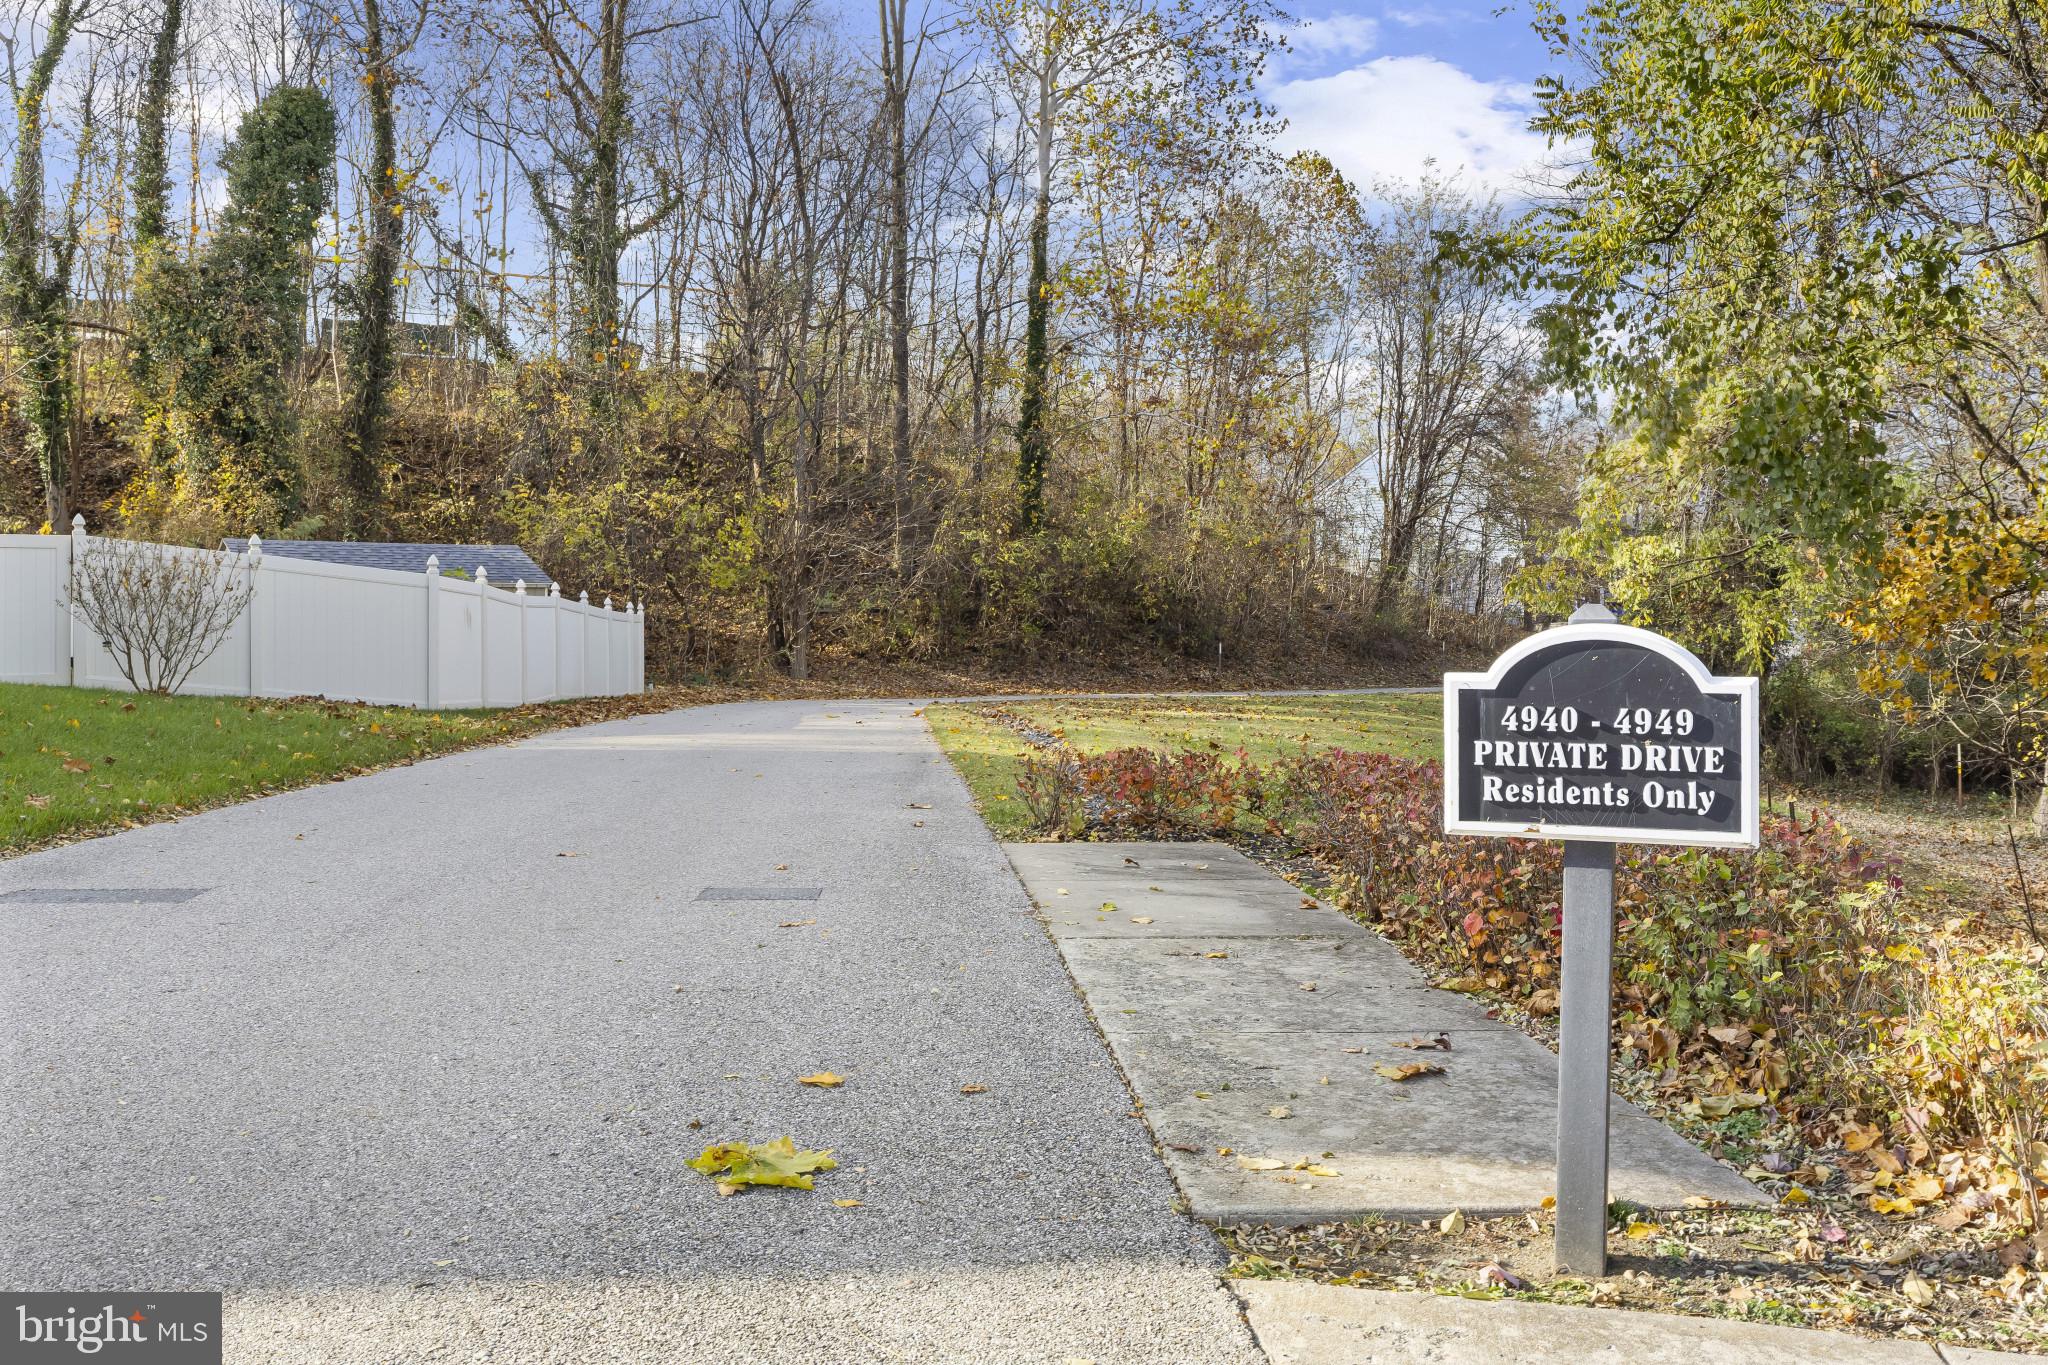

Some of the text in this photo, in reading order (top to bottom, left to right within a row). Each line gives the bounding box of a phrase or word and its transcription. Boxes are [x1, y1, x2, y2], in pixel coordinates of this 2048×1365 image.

[1501, 705, 1578, 733] 4940
[1613, 707, 1695, 736] 4949
[1473, 740, 1725, 774] PRIVATE DRIVE
[1482, 775, 1716, 816] Residents Only
